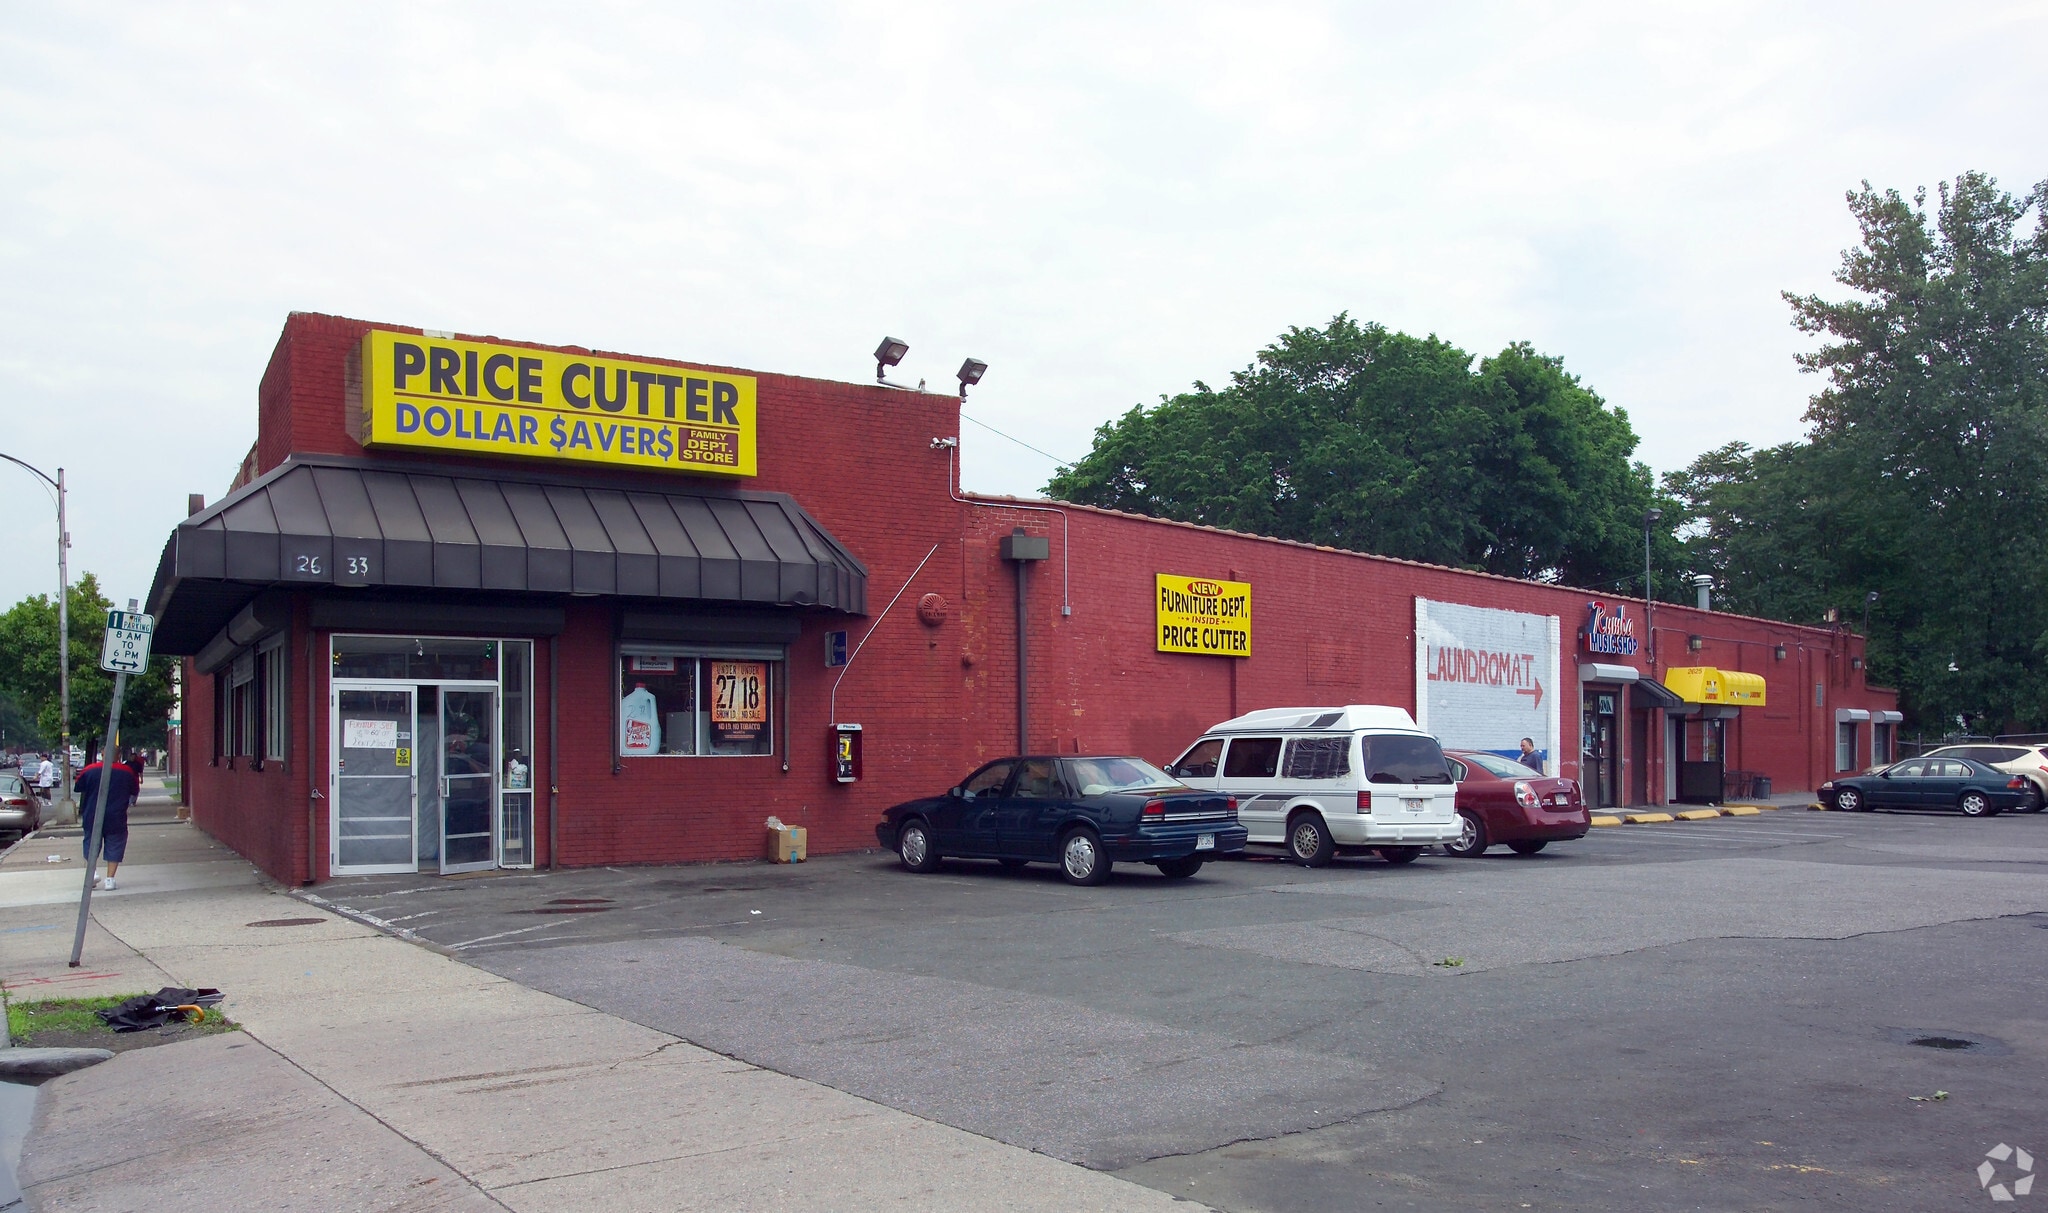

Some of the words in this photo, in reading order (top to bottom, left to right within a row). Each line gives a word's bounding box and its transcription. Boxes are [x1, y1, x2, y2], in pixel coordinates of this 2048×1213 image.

[393, 341, 543, 404] PRICE
[560, 362, 740, 426] CUTTER
[396, 402, 539, 445] DOLLAR
[550, 414, 674, 461] $AVER$
[690, 430, 727, 440] FAMILY
[687, 438, 733, 452] DEPT.
[683, 449, 734, 464] STORE
[296, 555, 321, 574] 26
[348, 556, 368, 576] 33
[1192, 582, 1219, 596] NEW
[1161, 586, 1218, 616] FURNITURE
[1221, 595, 1248, 618] DEPT.
[113, 613, 119, 628] 1
[123, 621, 149, 631] PARKING
[1191, 616, 1220, 625] INSIDE
[1590, 601, 1634, 637] Rumba
[126, 632, 141, 641] AM
[1163, 625, 1198, 648] PRICE
[1202, 627, 1247, 651] CUTTER
[1589, 632, 1617, 653] MUSIC
[1617, 636, 1638, 655] SHOP
[122, 641, 134, 649] TO
[124, 651, 139, 660] PM
[1427, 645, 1534, 687] LAUNDROMAT
[716, 675, 736, 709] 27
[742, 676, 759, 709] 18
